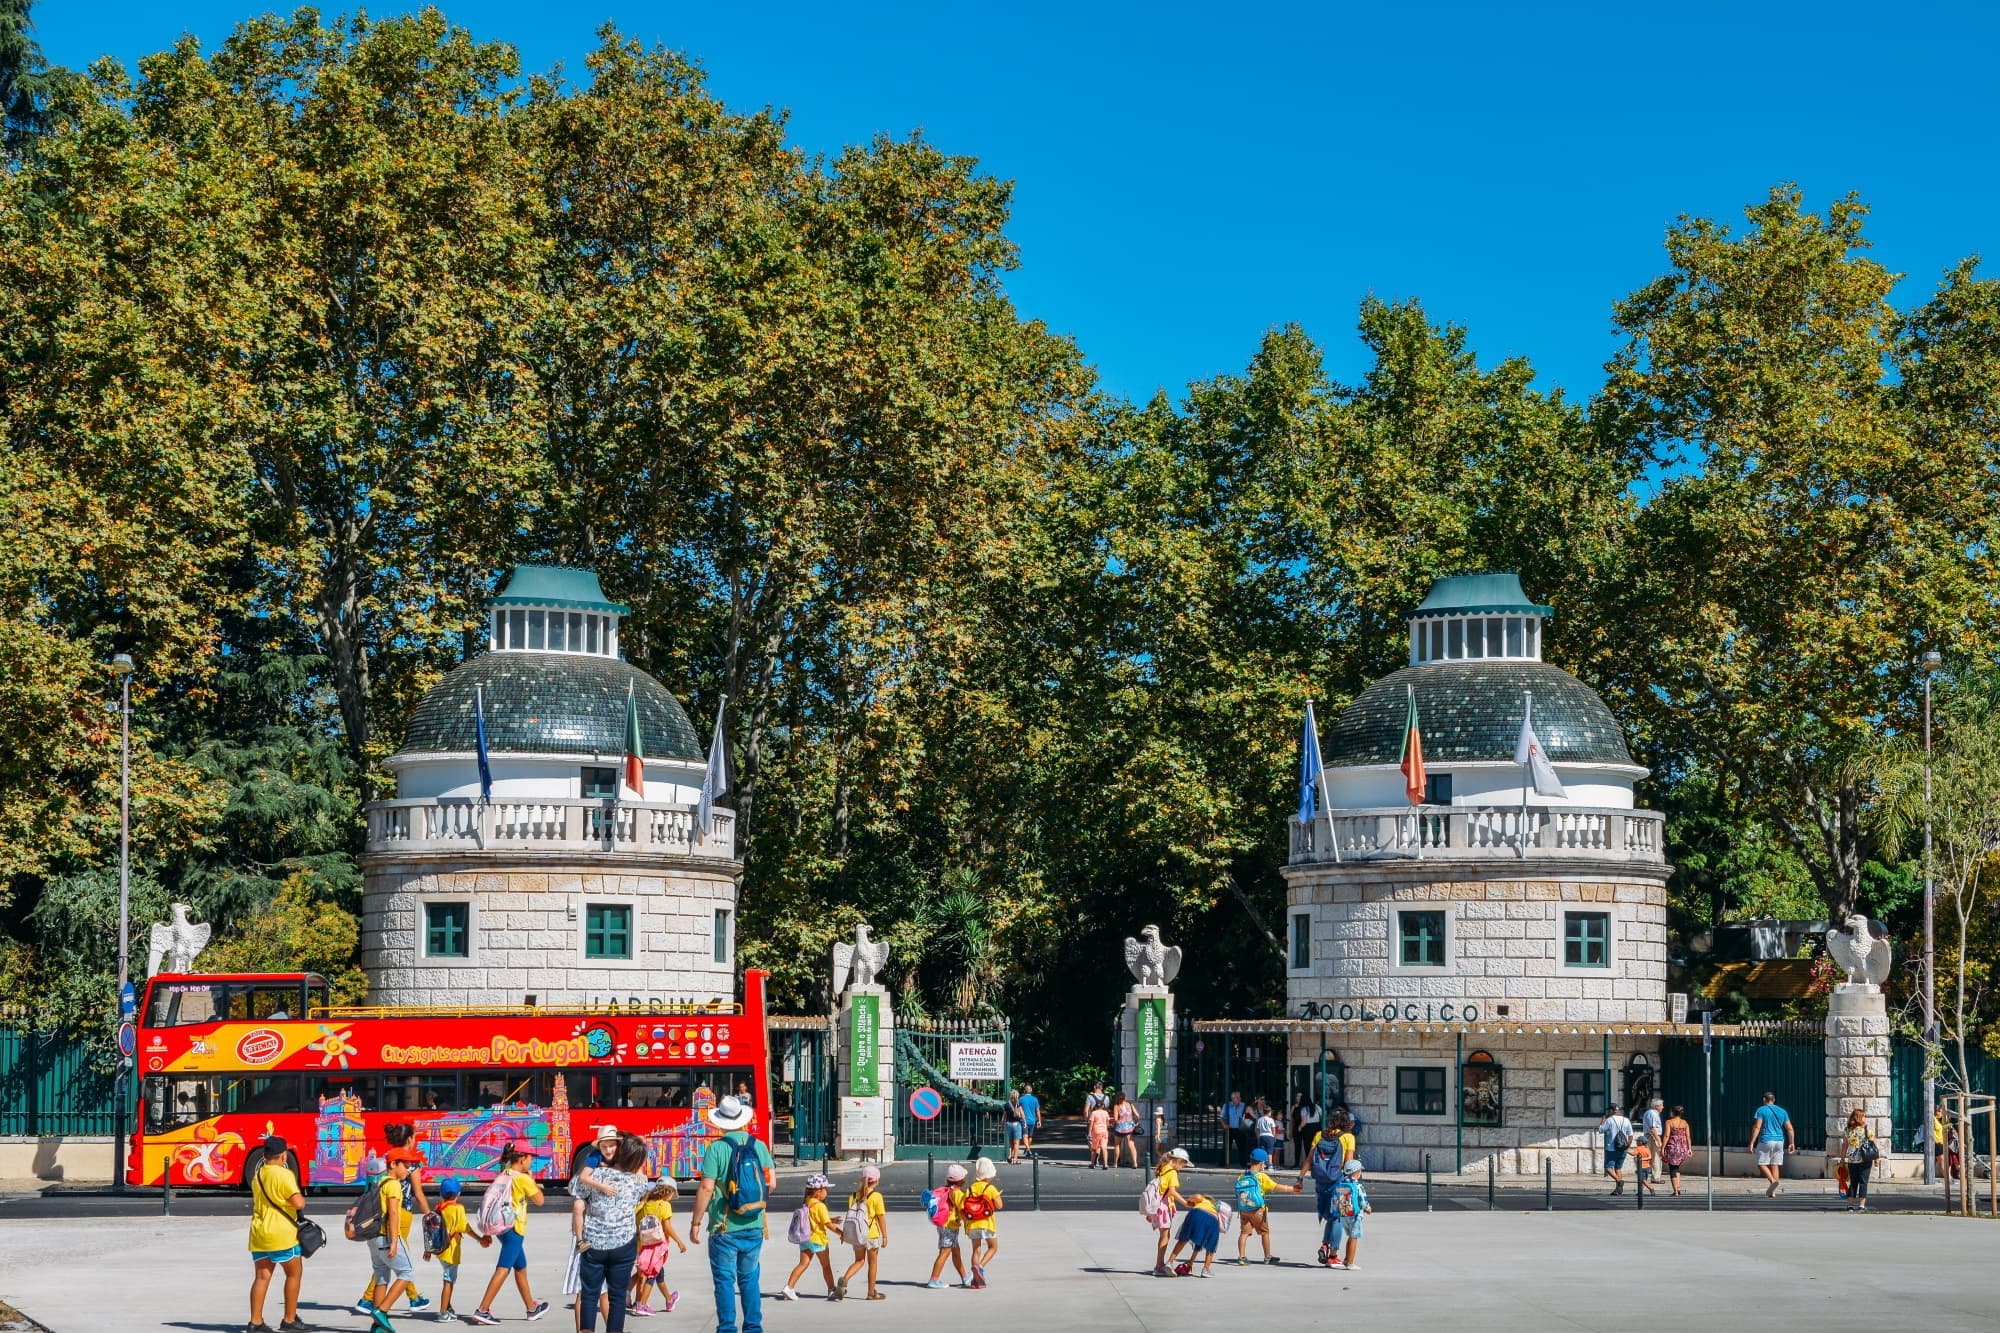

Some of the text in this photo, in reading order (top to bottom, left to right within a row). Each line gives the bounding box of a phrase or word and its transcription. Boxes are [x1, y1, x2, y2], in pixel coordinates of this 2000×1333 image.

[586, 997, 694, 1015] JARDIM
[857, 1004, 867, 1033] Silêncio
[1144, 1007, 1153, 1036] Silêncio
[192, 1041, 205, 1054] 24
[381, 1035, 589, 1067] CitySightseeing Portugal
[857, 1040, 868, 1066] Quebra
[958, 1046, 997, 1056] ATENÇÃO
[1144, 1044, 1155, 1069] Quebra
